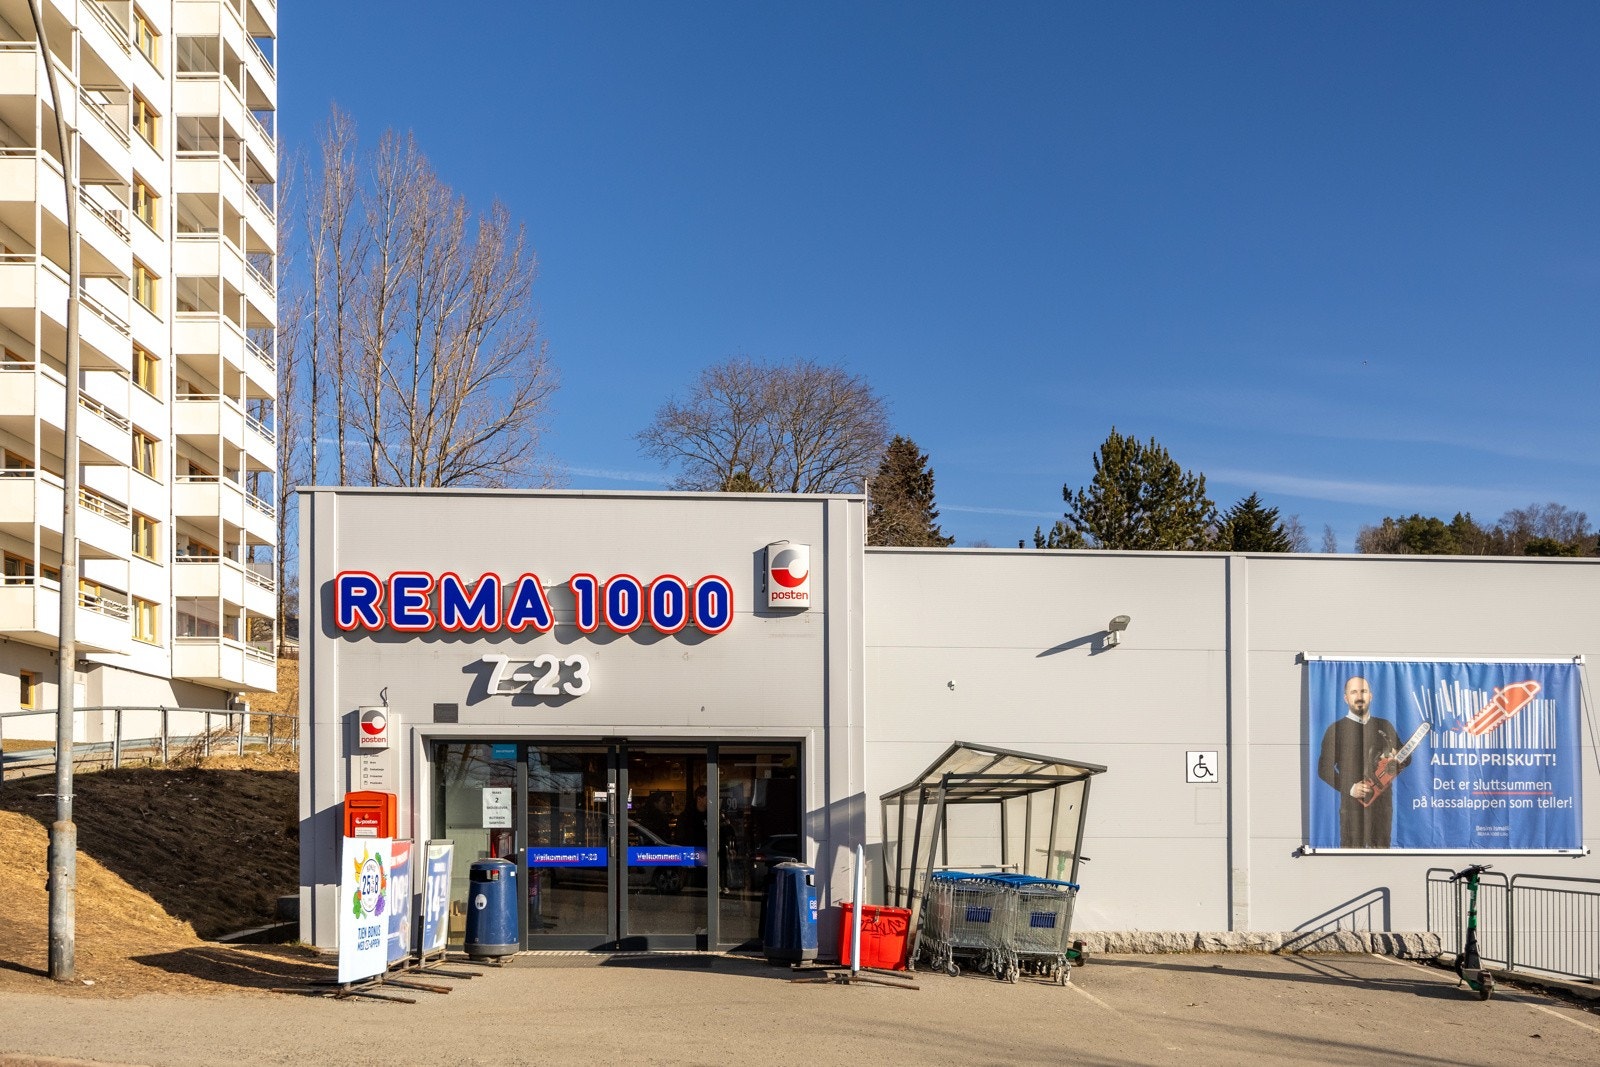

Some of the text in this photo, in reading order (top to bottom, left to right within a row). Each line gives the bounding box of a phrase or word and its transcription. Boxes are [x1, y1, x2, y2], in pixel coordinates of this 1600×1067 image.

[335, 570, 733, 634] REMA 1000
[771, 590, 809, 601] posten
[482, 654, 591, 695] 7-23
[361, 736, 387, 744] posten
[1430, 753, 1557, 766] ALLTID PRISKUTT!
[1433, 778, 1552, 791] Det er sluttsummen
[1412, 796, 1573, 810] på kassalappen som teller!
[534, 853, 579, 861] Velkommen!
[636, 852, 700, 861] Velkommen! 7-23
[362, 874, 371, 896] 25
